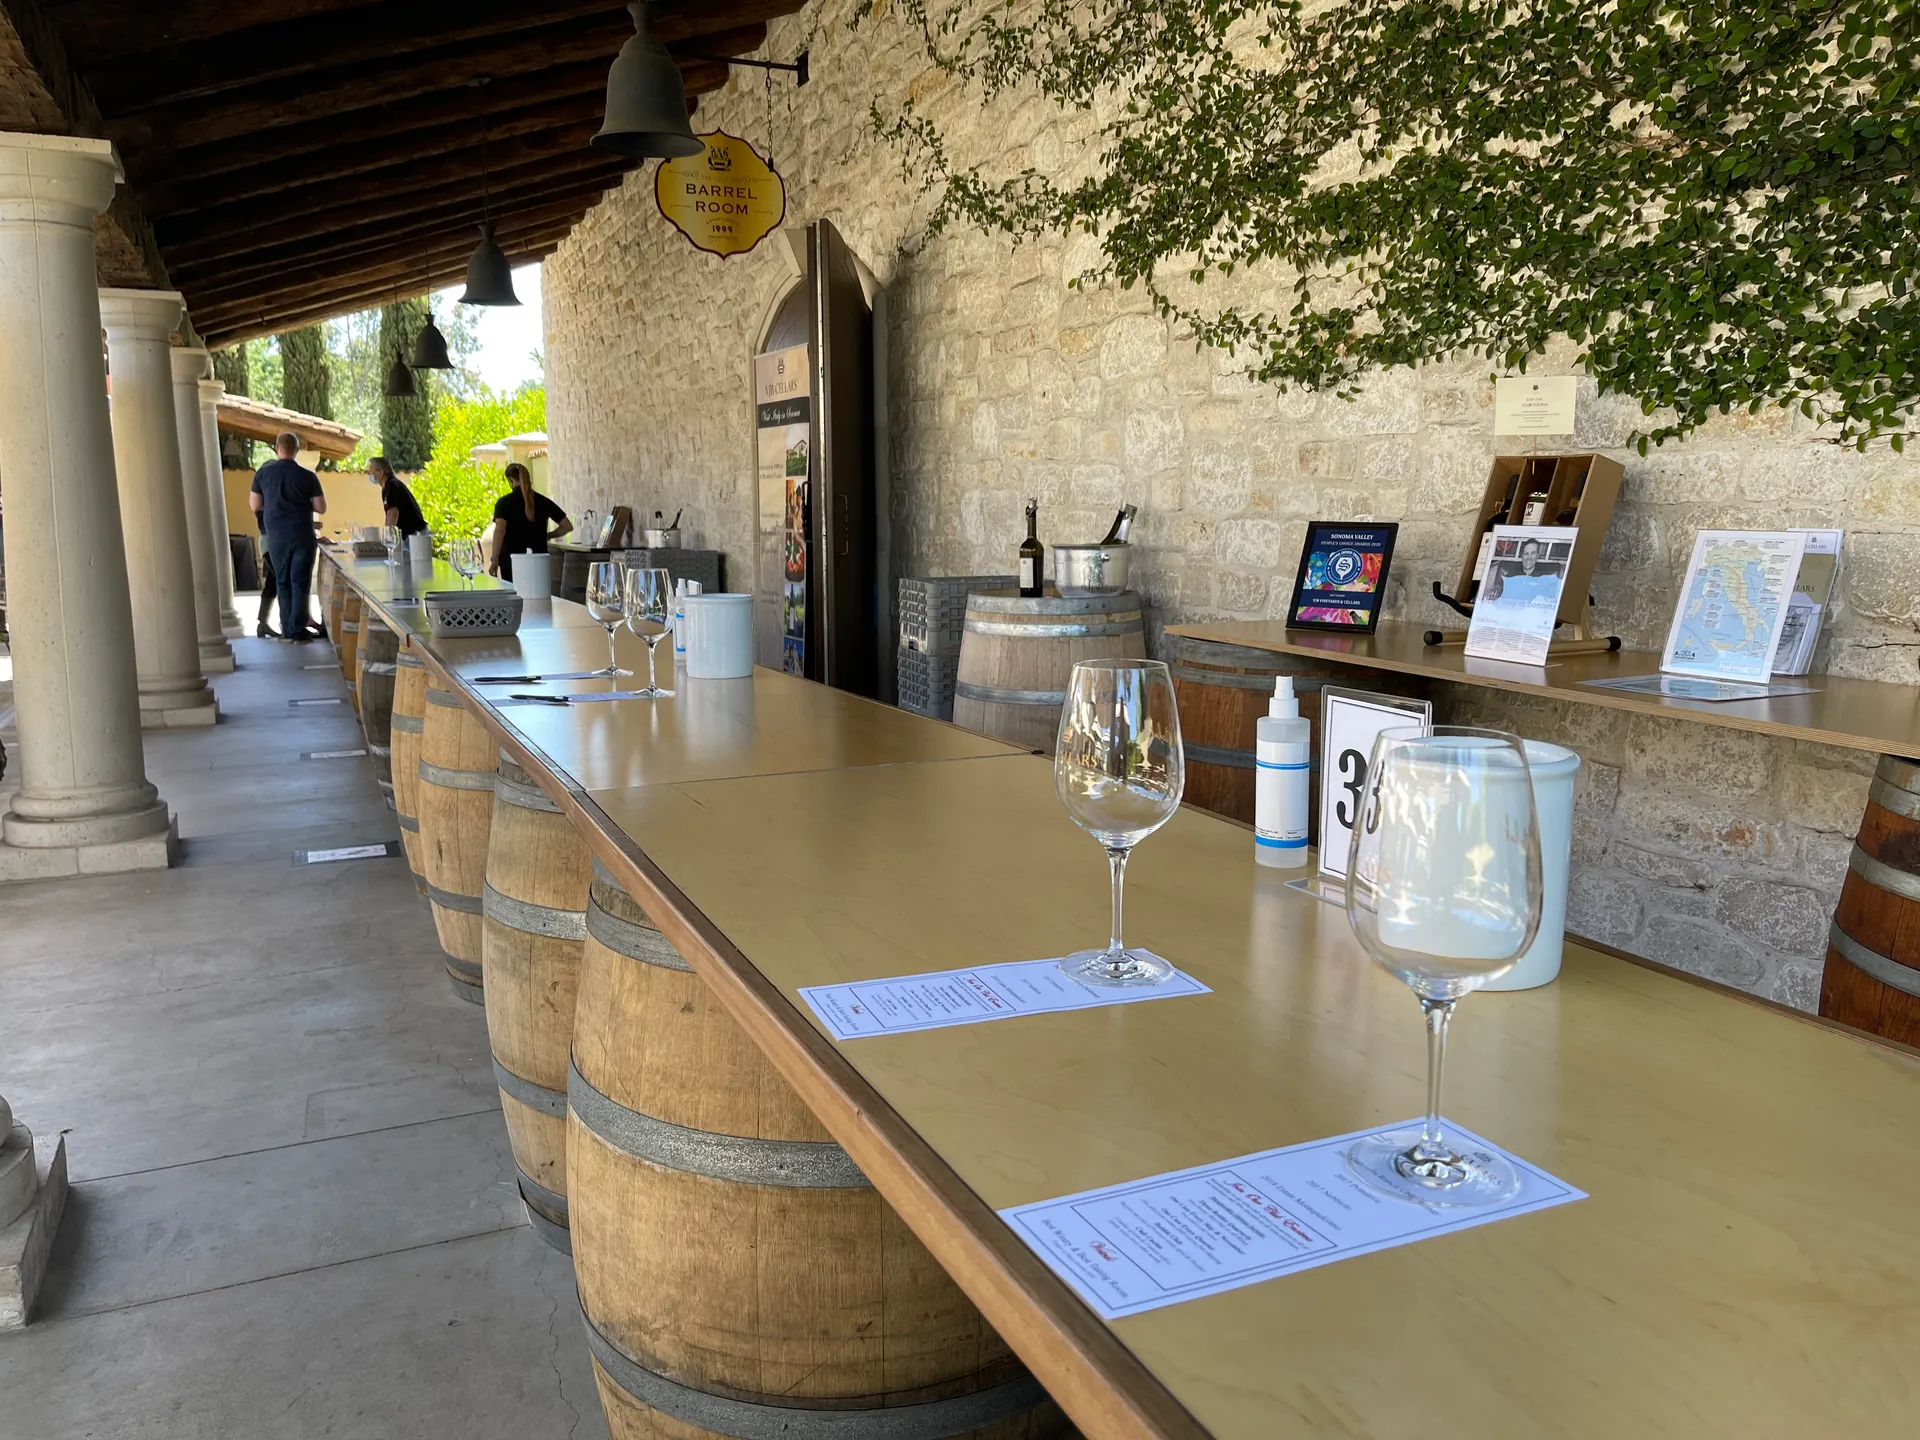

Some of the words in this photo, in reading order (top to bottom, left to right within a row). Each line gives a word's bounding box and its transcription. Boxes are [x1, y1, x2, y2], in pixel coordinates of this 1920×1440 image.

[685, 183, 758, 199] BARREL
[695, 201, 748, 215] ROOM
[712, 224, 733, 233] 1999
[775, 380, 798, 394] CELLARS
